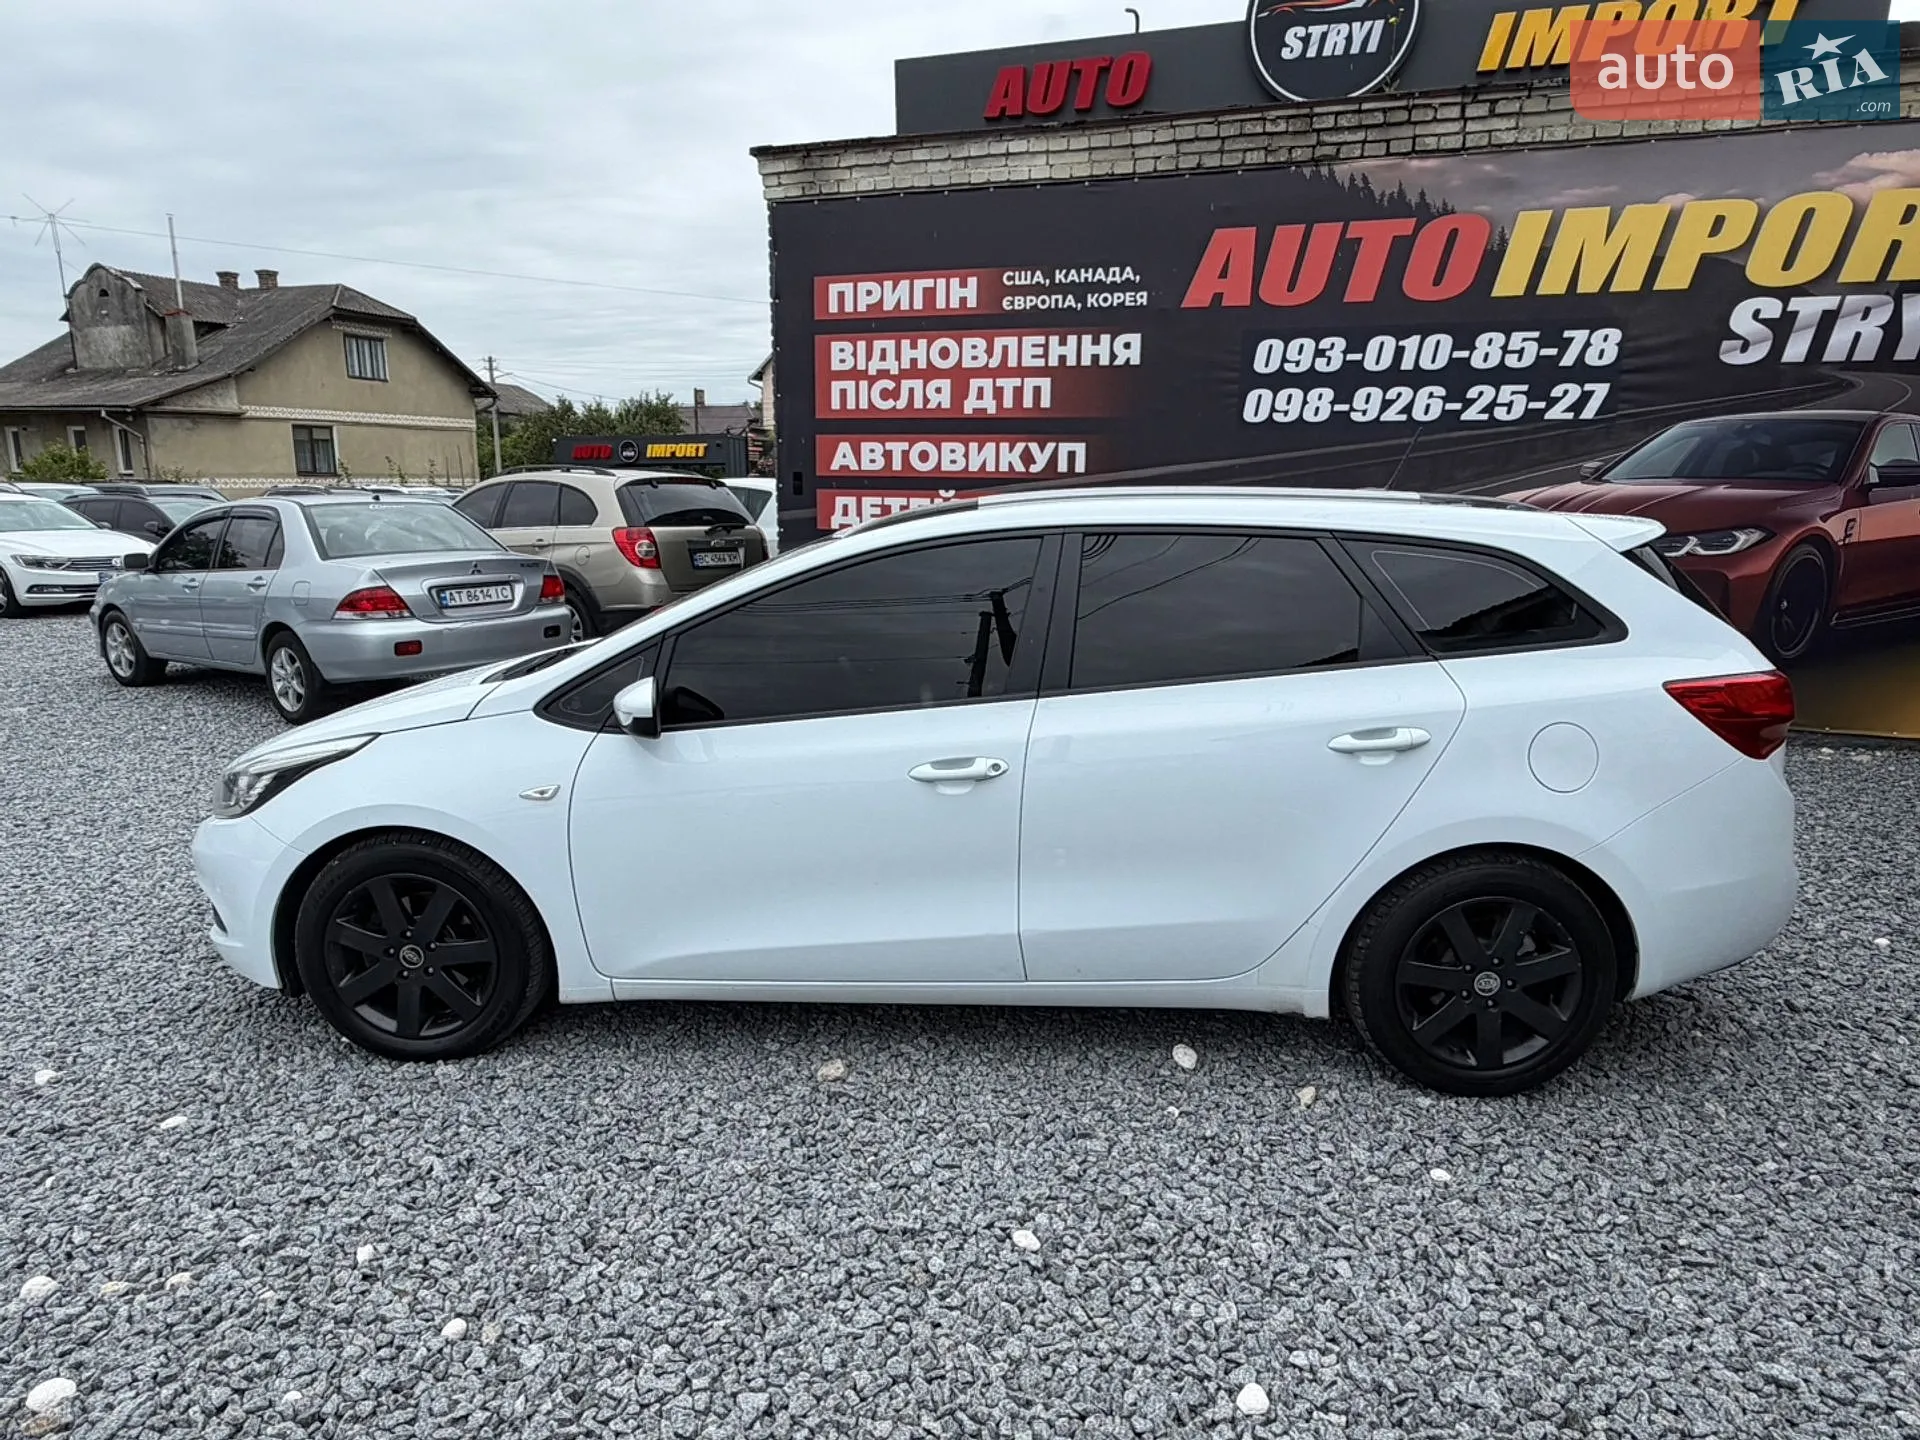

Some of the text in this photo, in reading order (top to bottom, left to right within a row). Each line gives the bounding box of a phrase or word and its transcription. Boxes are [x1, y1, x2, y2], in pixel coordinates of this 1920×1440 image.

[1281, 19, 1386, 60] STRYI
[983, 51, 1152, 119] AUTO
[1002, 266, 1141, 288] США, КАНАДА,
[1181, 213, 1491, 308] AUTO
[828, 276, 978, 313] ПРИГІН
[1002, 291, 1148, 311] ЄВРОПА, КОРЕЯ
[830, 333, 1142, 375] ВІДНОВЛЕННЯ
[1253, 328, 1623, 374] 093-010-85-78
[830, 377, 1052, 415] ПІСЛЯ ДТП
[1242, 383, 1612, 424] 098-926-25-27
[646, 443, 708, 458] IMPORT
[830, 441, 1087, 474] АВТОВИКУП
[449, 590, 464, 604] AT
[466, 588, 492, 602] 8614
